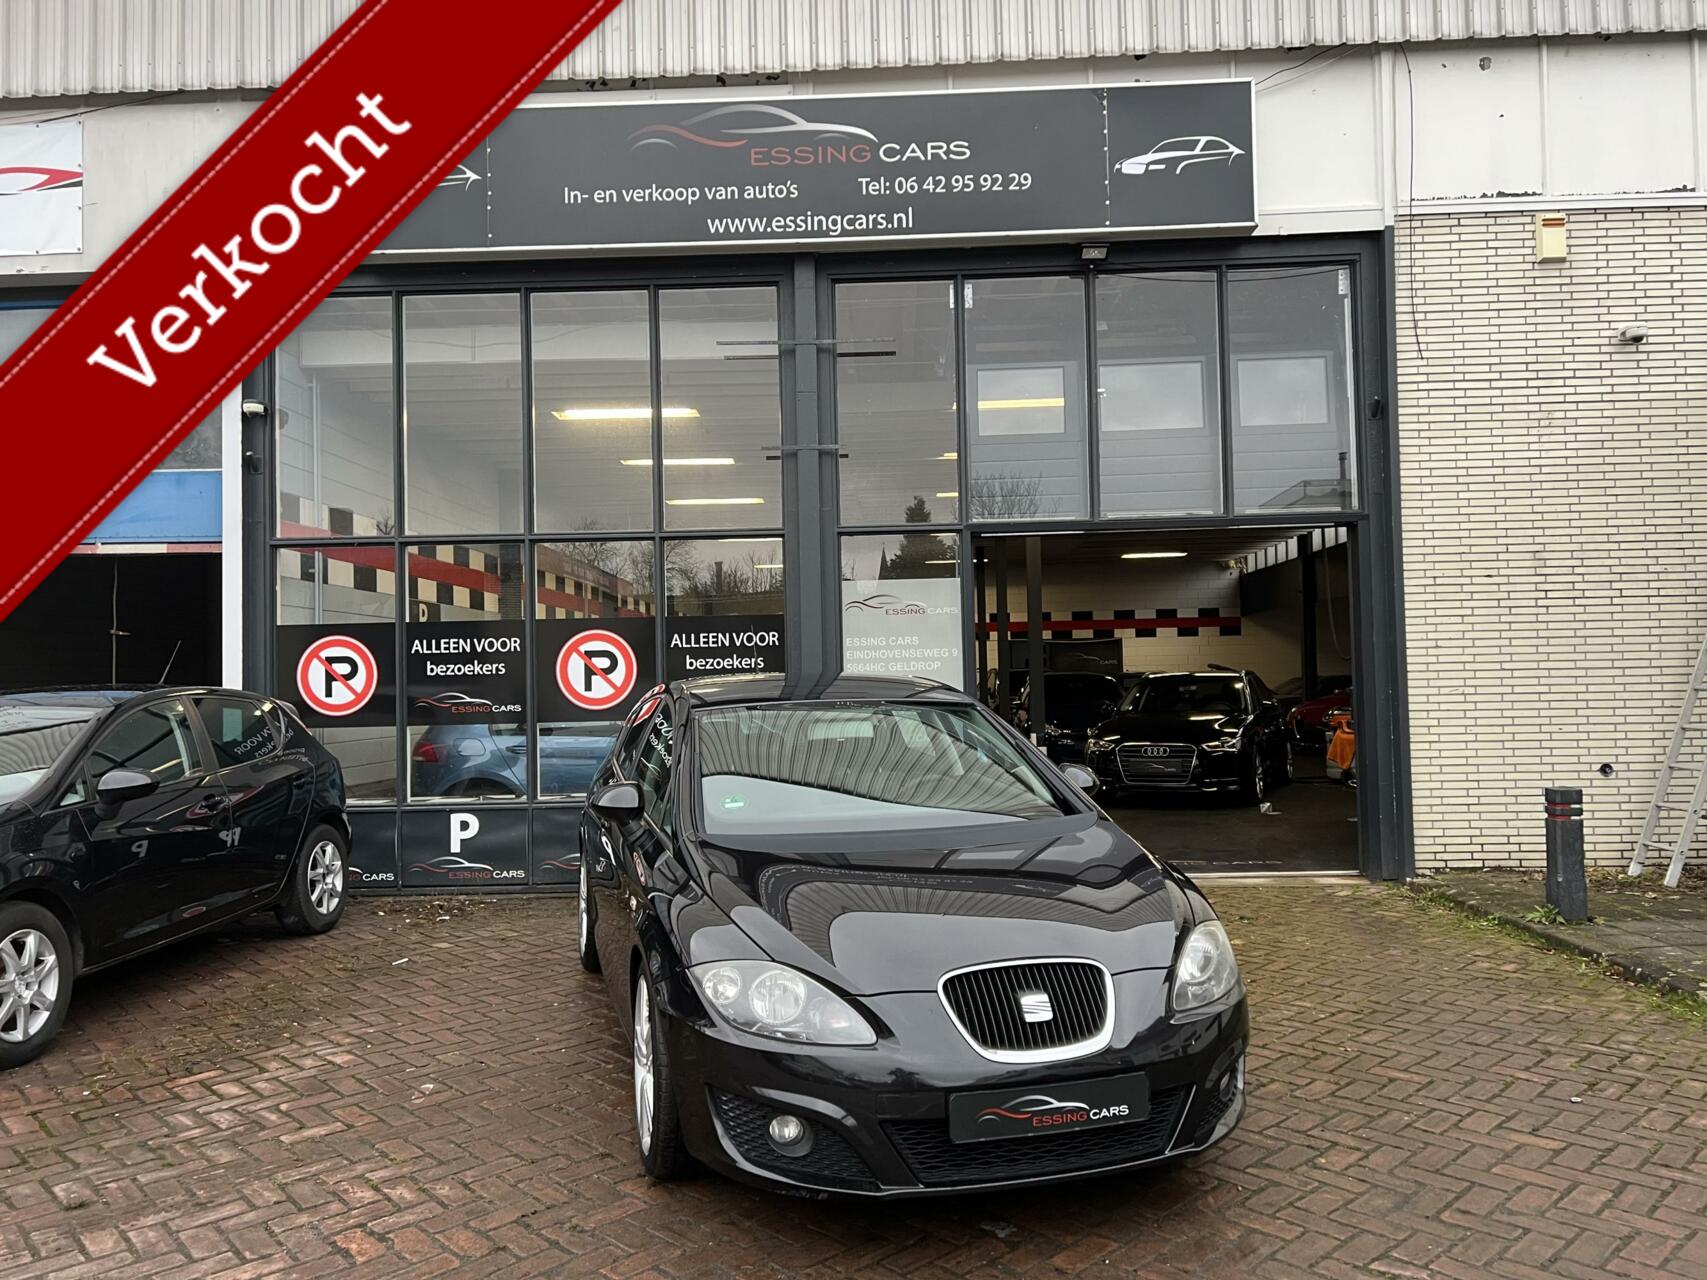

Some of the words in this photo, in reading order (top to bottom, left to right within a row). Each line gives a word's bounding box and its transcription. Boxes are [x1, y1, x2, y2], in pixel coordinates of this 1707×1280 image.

[751, 145, 871, 166] ESSING
[879, 141, 971, 163] CARS
[858, 176, 890, 195] Tel:
[895, 176, 919, 194] 06
[923, 175, 947, 193] 42
[952, 174, 975, 193] 95
[980, 173, 1003, 192] 92
[1008, 172, 1032, 190] 29
[564, 187, 589, 204] In-
[593, 188, 617, 203] en
[622, 184, 700, 205] verkoop
[705, 186, 738, 200] van
[707, 206, 913, 235] www.essingcars.nl
[884, 608, 926, 616] ESSING
[927, 606, 961, 615] CARS
[411, 638, 471, 654] ALLEEN
[473, 637, 521, 653] VOOR
[670, 632, 730, 648] ALLEEN
[732, 631, 779, 647] VOOR
[846, 637, 886, 646] ESSING
[888, 636, 920, 645] CARS
[685, 653, 765, 670] bezoekers
[846, 648, 949, 660] EINDHOVENSEWEG
[951, 647, 959, 657] 9
[426, 659, 506, 676] bezoekers
[847, 662, 886, 673] 5664HC
[888, 661, 941, 671] GELDROP
[451, 705, 491, 713] ESSING
[492, 704, 522, 712] CARS
[450, 813, 480, 853] P
[362, 873, 395, 882] CARS
[448, 871, 491, 880] ESSING
[492, 870, 526, 879] CARS
[1032, 1111, 1088, 1127] ESSING
[1089, 1105, 1130, 1120] CARS
